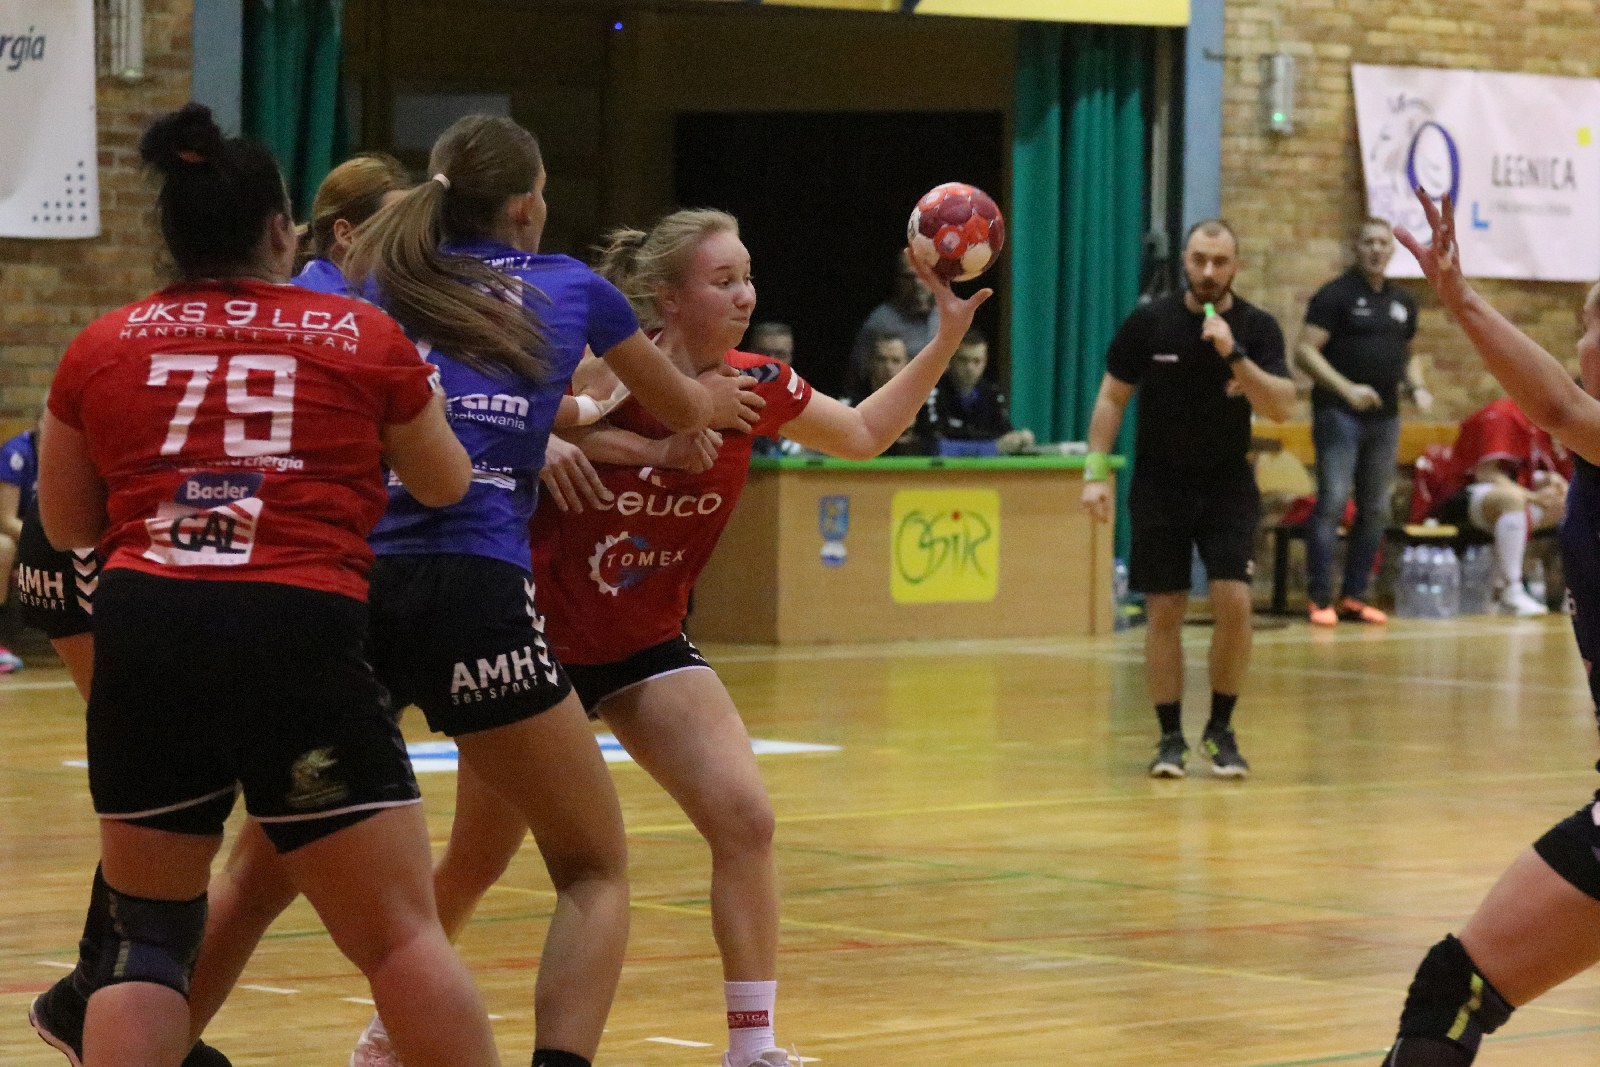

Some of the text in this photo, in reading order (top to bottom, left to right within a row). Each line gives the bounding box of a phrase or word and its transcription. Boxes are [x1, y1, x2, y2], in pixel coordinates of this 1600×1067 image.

[127, 300, 361, 337] UKS 9 LCA
[119, 327, 358, 354] HANDBALL TEAM
[145, 354, 297, 457] 79
[169, 511, 247, 554] GAL
[607, 549, 687, 568] TOMEX
[18, 563, 64, 599] AMH
[450, 645, 536, 694] AMH
[451, 674, 538, 705] 365 SPORT
